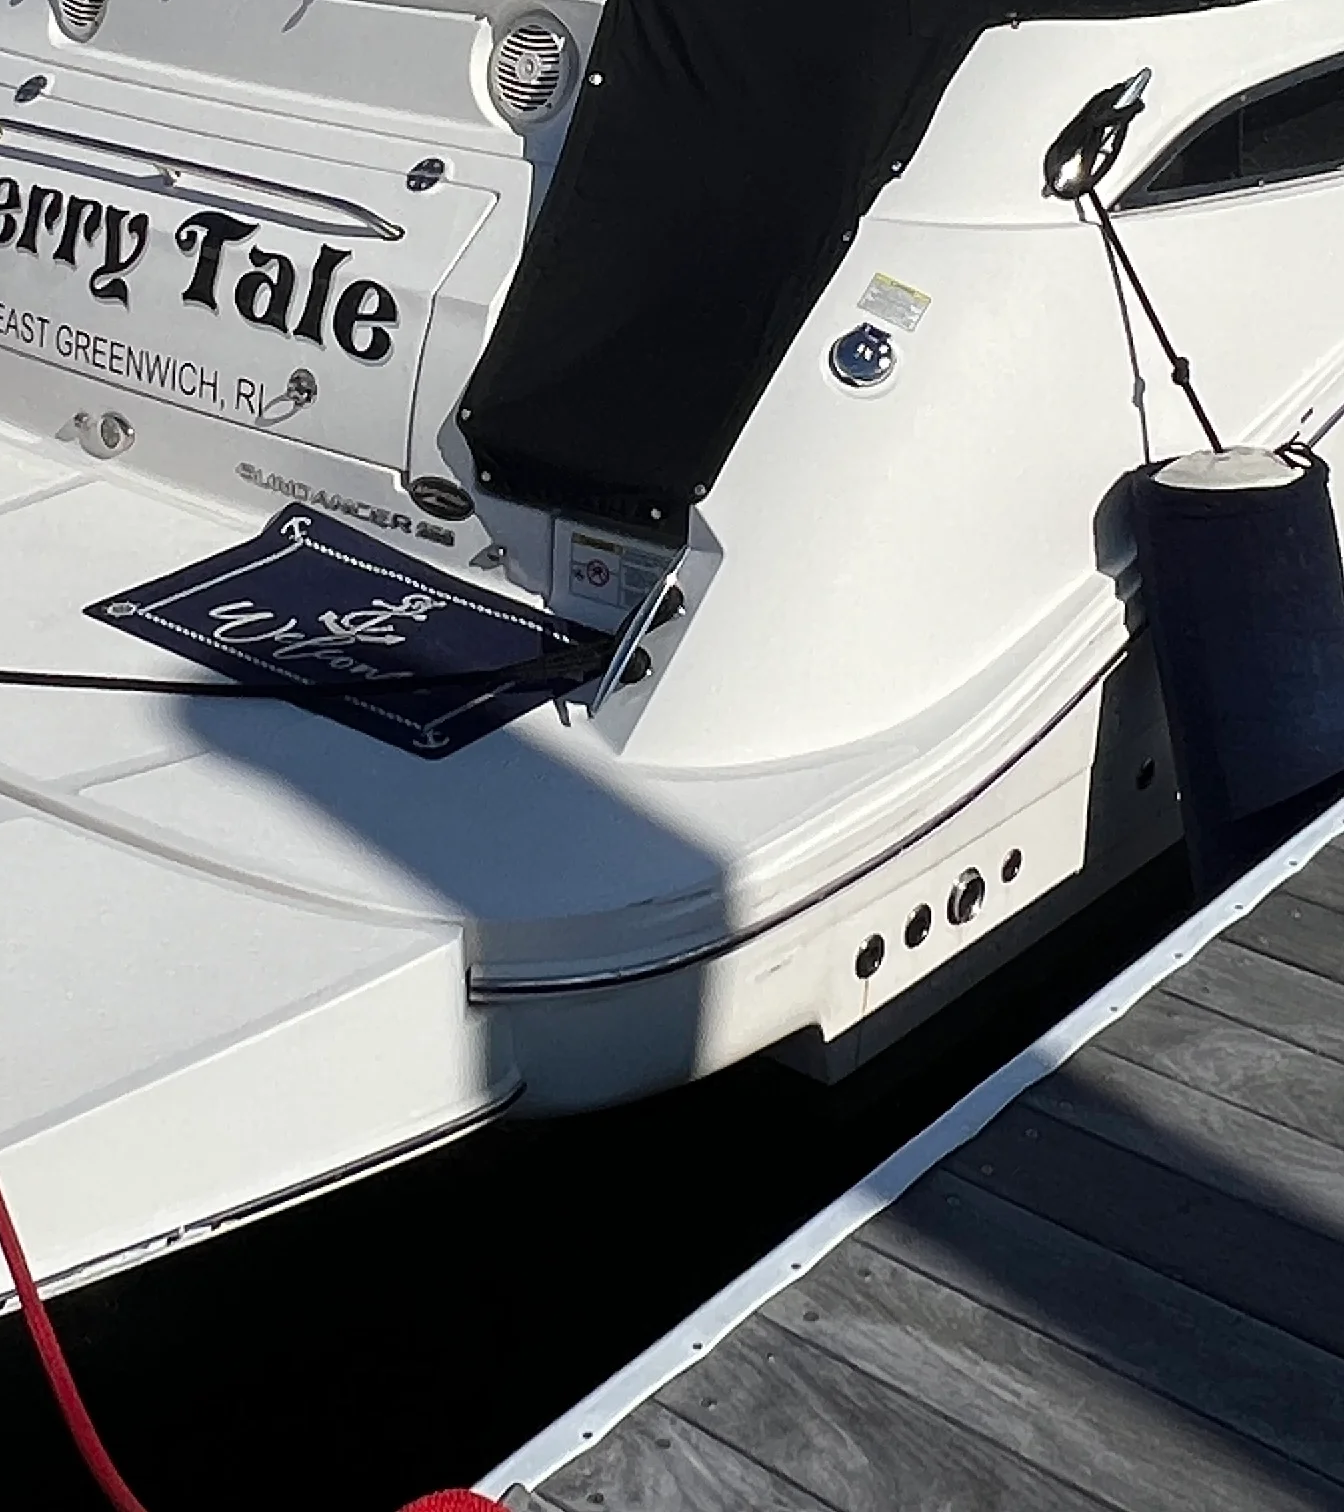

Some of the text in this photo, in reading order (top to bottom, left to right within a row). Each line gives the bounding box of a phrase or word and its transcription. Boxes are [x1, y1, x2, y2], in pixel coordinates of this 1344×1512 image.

[175, 210, 400, 363] Tale
[55, 323, 226, 411] GREENWICH,
[234, 377, 265, 419] RI
